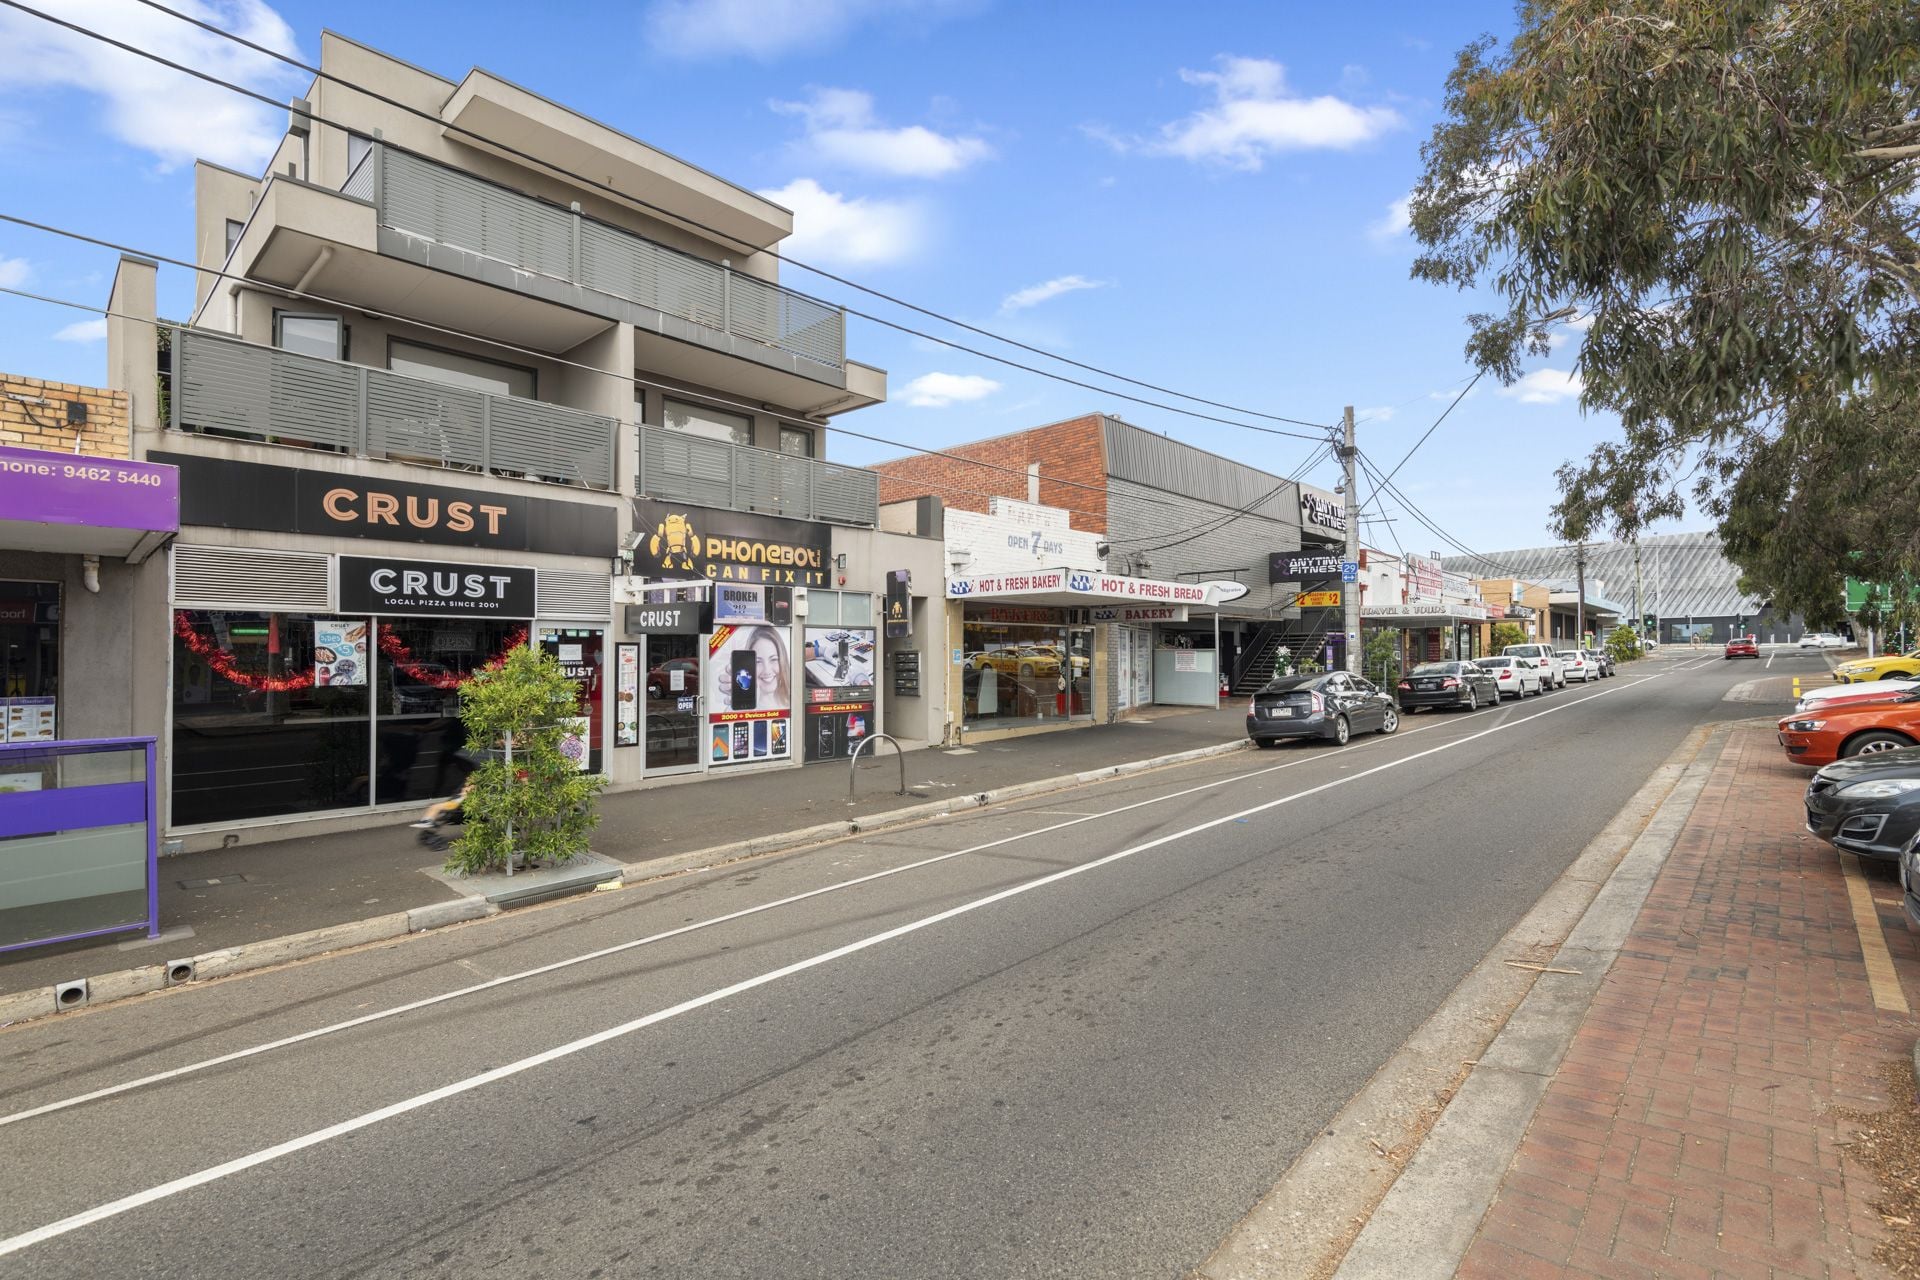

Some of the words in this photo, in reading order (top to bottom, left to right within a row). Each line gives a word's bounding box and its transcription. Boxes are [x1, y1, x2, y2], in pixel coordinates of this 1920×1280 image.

[63, 465, 111, 481] 9462
[117, 471, 161, 487] 5440
[322, 488, 507, 535] CRUST
[1008, 535, 1029, 550] OPEN
[1031, 531, 1042, 554] 7
[1044, 541, 1063, 554] DAYS
[706, 564, 749, 580] CAN
[761, 568, 795, 583] FIX
[806, 571, 824, 585] IT
[1343, 564, 1356, 573] 29
[370, 568, 511, 599] CRUST
[979, 580, 995, 593] HOT
[997, 579, 1002, 591] &
[1005, 577, 1030, 591] FRESH
[1032, 574, 1061, 589] BAKERY
[1102, 579, 1125, 593] HOT
[1128, 582, 1136, 594] &
[1139, 583, 1170, 599] FRESH
[1174, 587, 1204, 601] BREAD
[385, 598, 416, 606] LOCAL
[419, 599, 446, 607] PIZZA
[724, 590, 758, 603] BROKEN
[1329, 593, 1338, 604] $2
[640, 610, 681, 627] CRUST
[1125, 608, 1176, 621] BAKERY
[559, 667, 594, 678] RUST
[678, 702, 694, 710] OPEN
